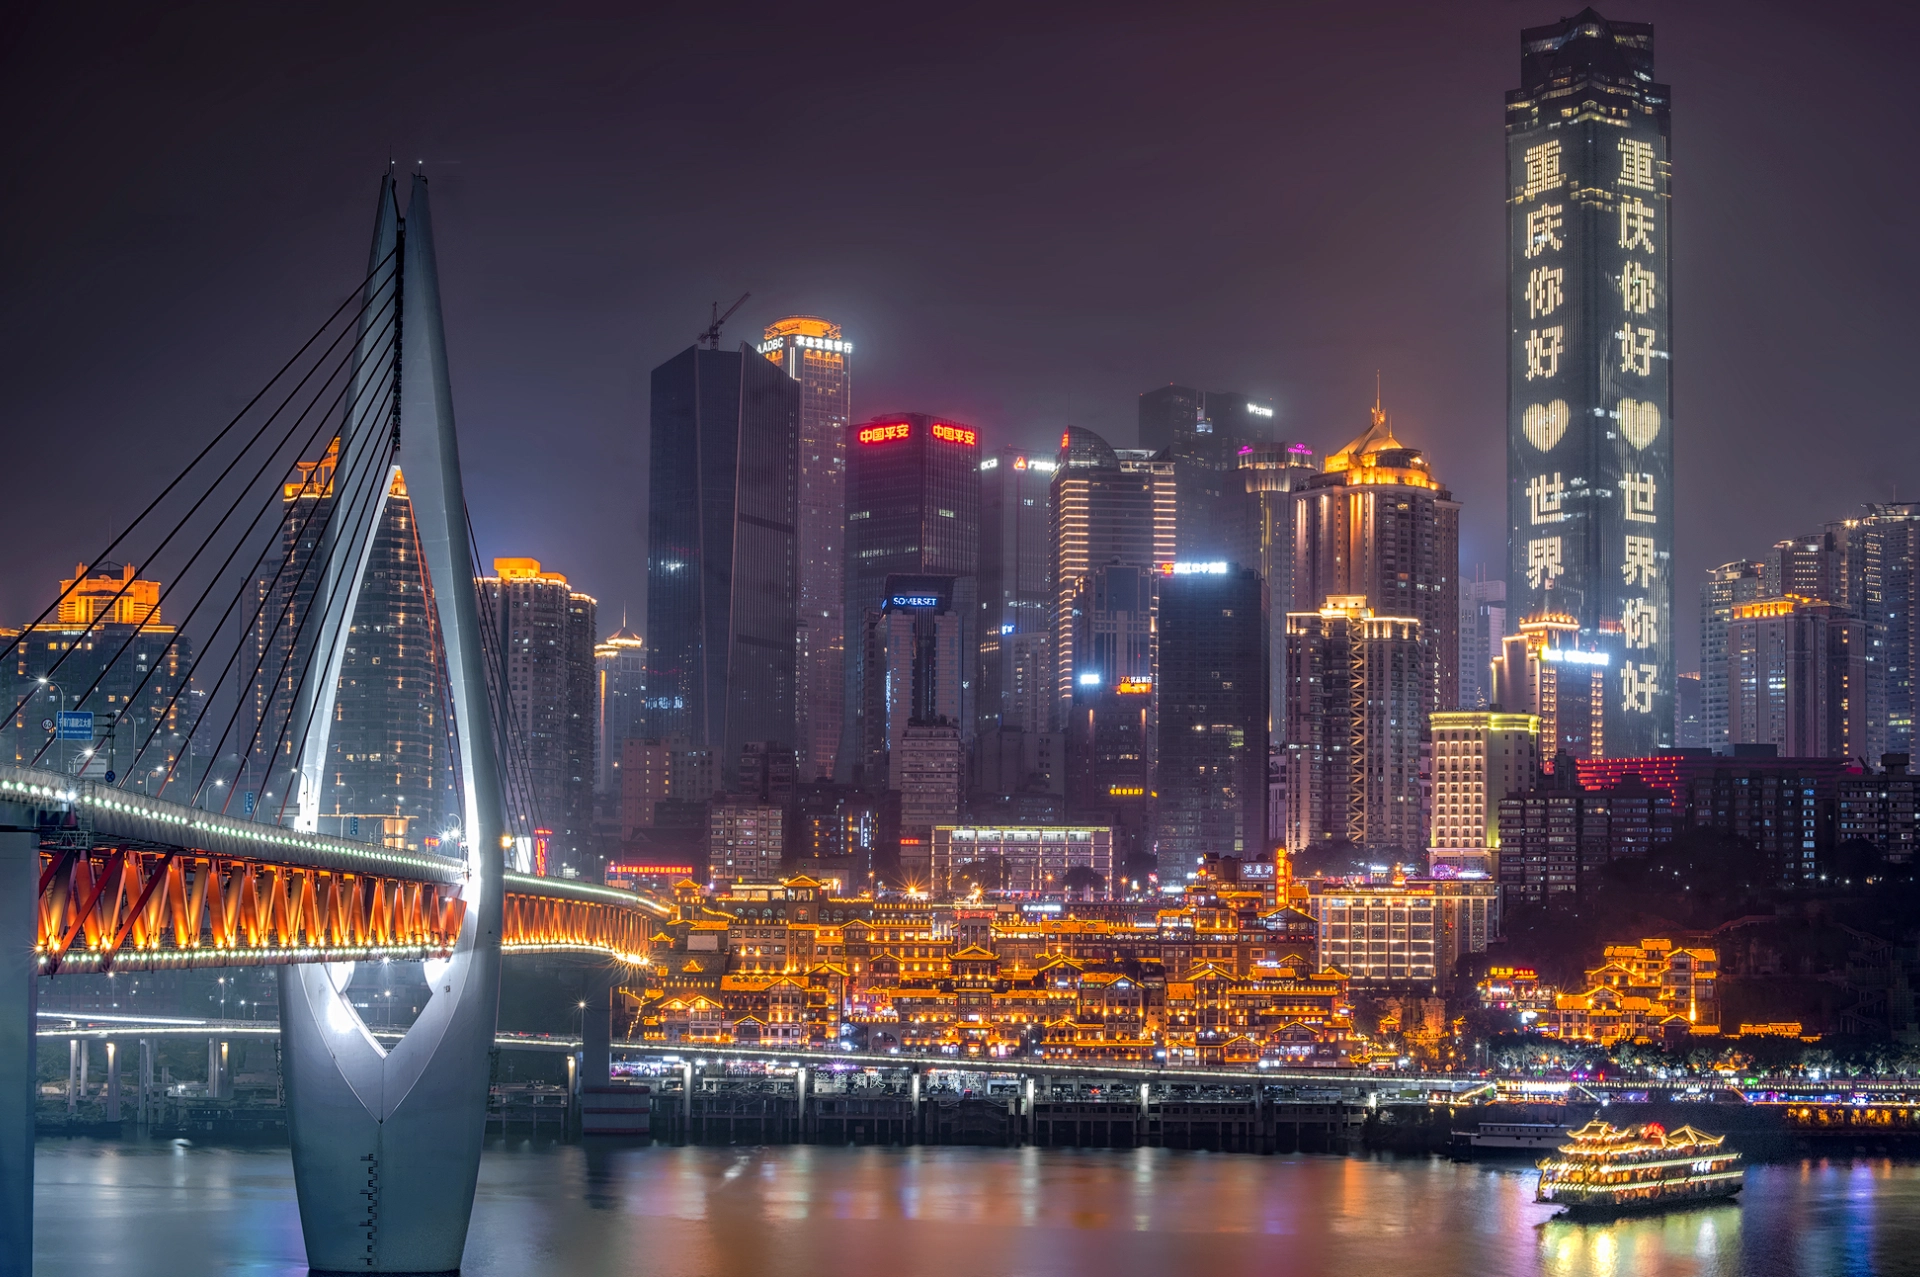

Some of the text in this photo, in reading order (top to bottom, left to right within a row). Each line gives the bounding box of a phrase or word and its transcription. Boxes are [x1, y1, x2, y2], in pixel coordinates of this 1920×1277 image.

[1524, 139, 1563, 382] 重庆你好
[860, 424, 909, 443] 中国平安
[932, 424, 976, 446] 中国平安
[1618, 137, 1658, 714] 重庆你好 世界你好
[893, 597, 937, 606] SOMERSET
[1243, 864, 1274, 875] 洪崖洞
